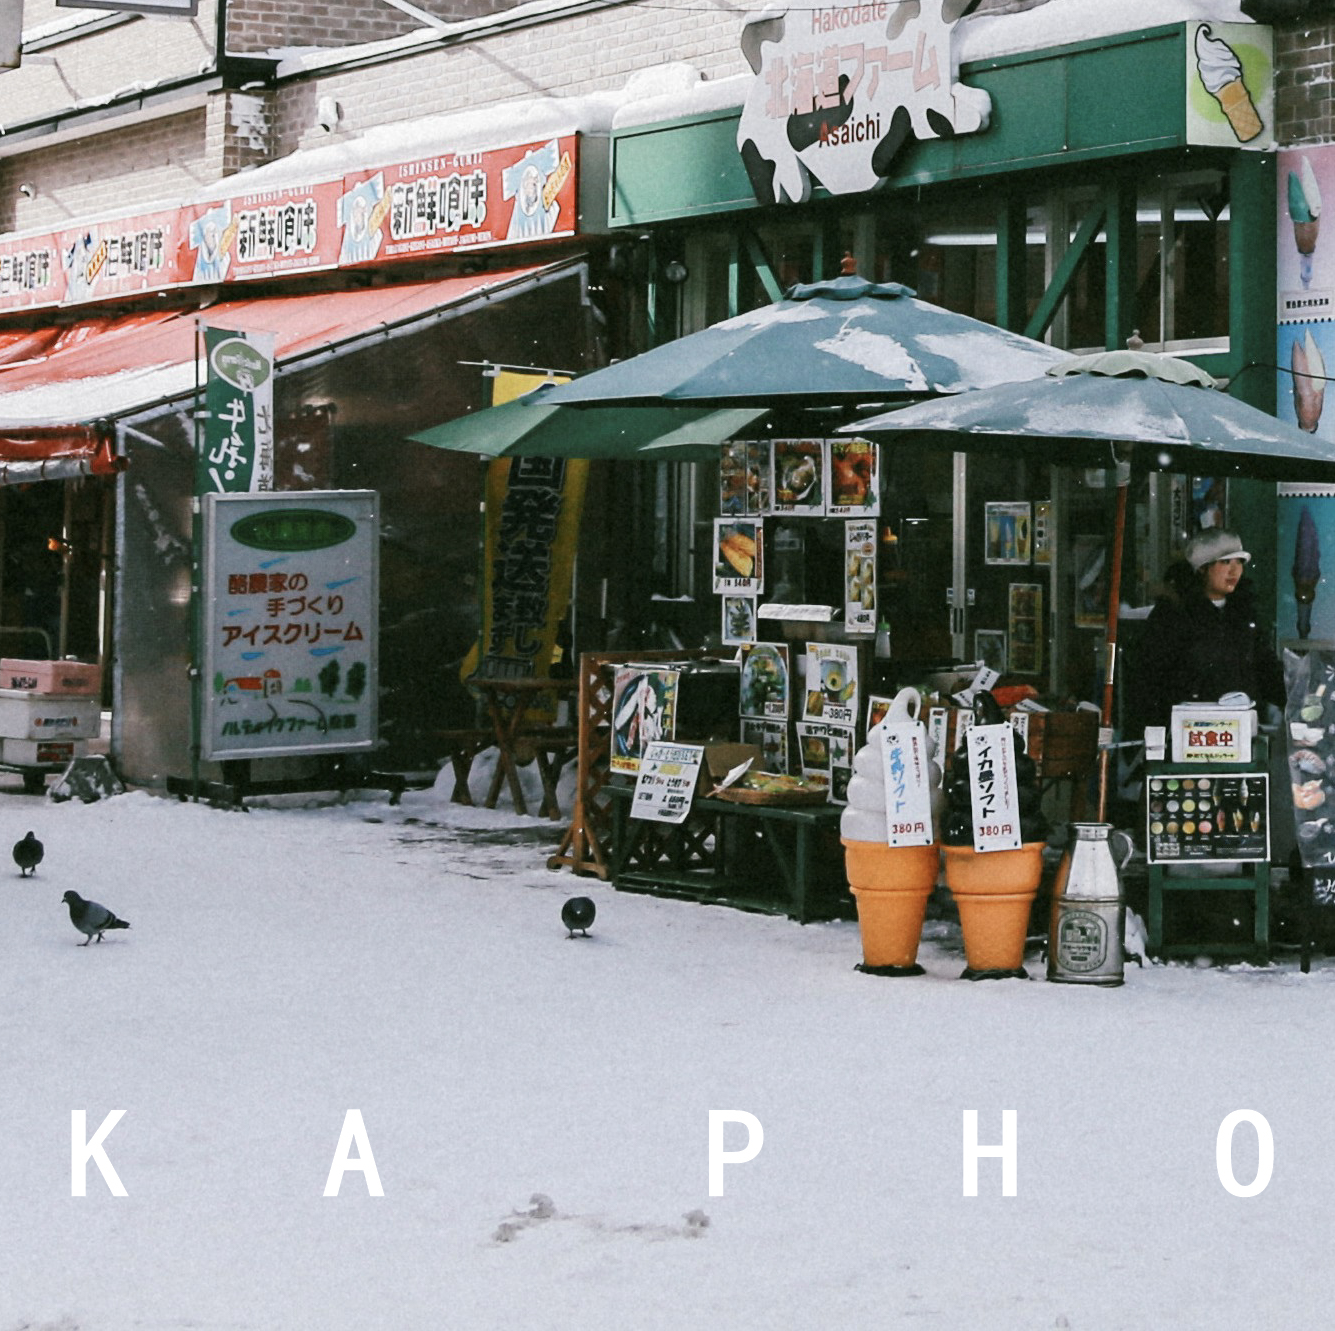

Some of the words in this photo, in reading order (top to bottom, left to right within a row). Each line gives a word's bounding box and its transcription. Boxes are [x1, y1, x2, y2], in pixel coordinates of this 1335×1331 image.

[764, 29, 942, 121] 北海道ファーム
[818, 111, 882, 148] Asaichi
[228, 572, 308, 594] 酪農家の
[267, 594, 344, 617] 手づくり
[222, 621, 364, 647] アイスクリーム
[1188, 730, 1234, 747] 試食中
[890, 747, 907, 814] 牛乳ソフト
[977, 745, 996, 819] イカ墨ソフト
[891, 822, 925, 834] 380円
[978, 824, 1012, 837] 380円
